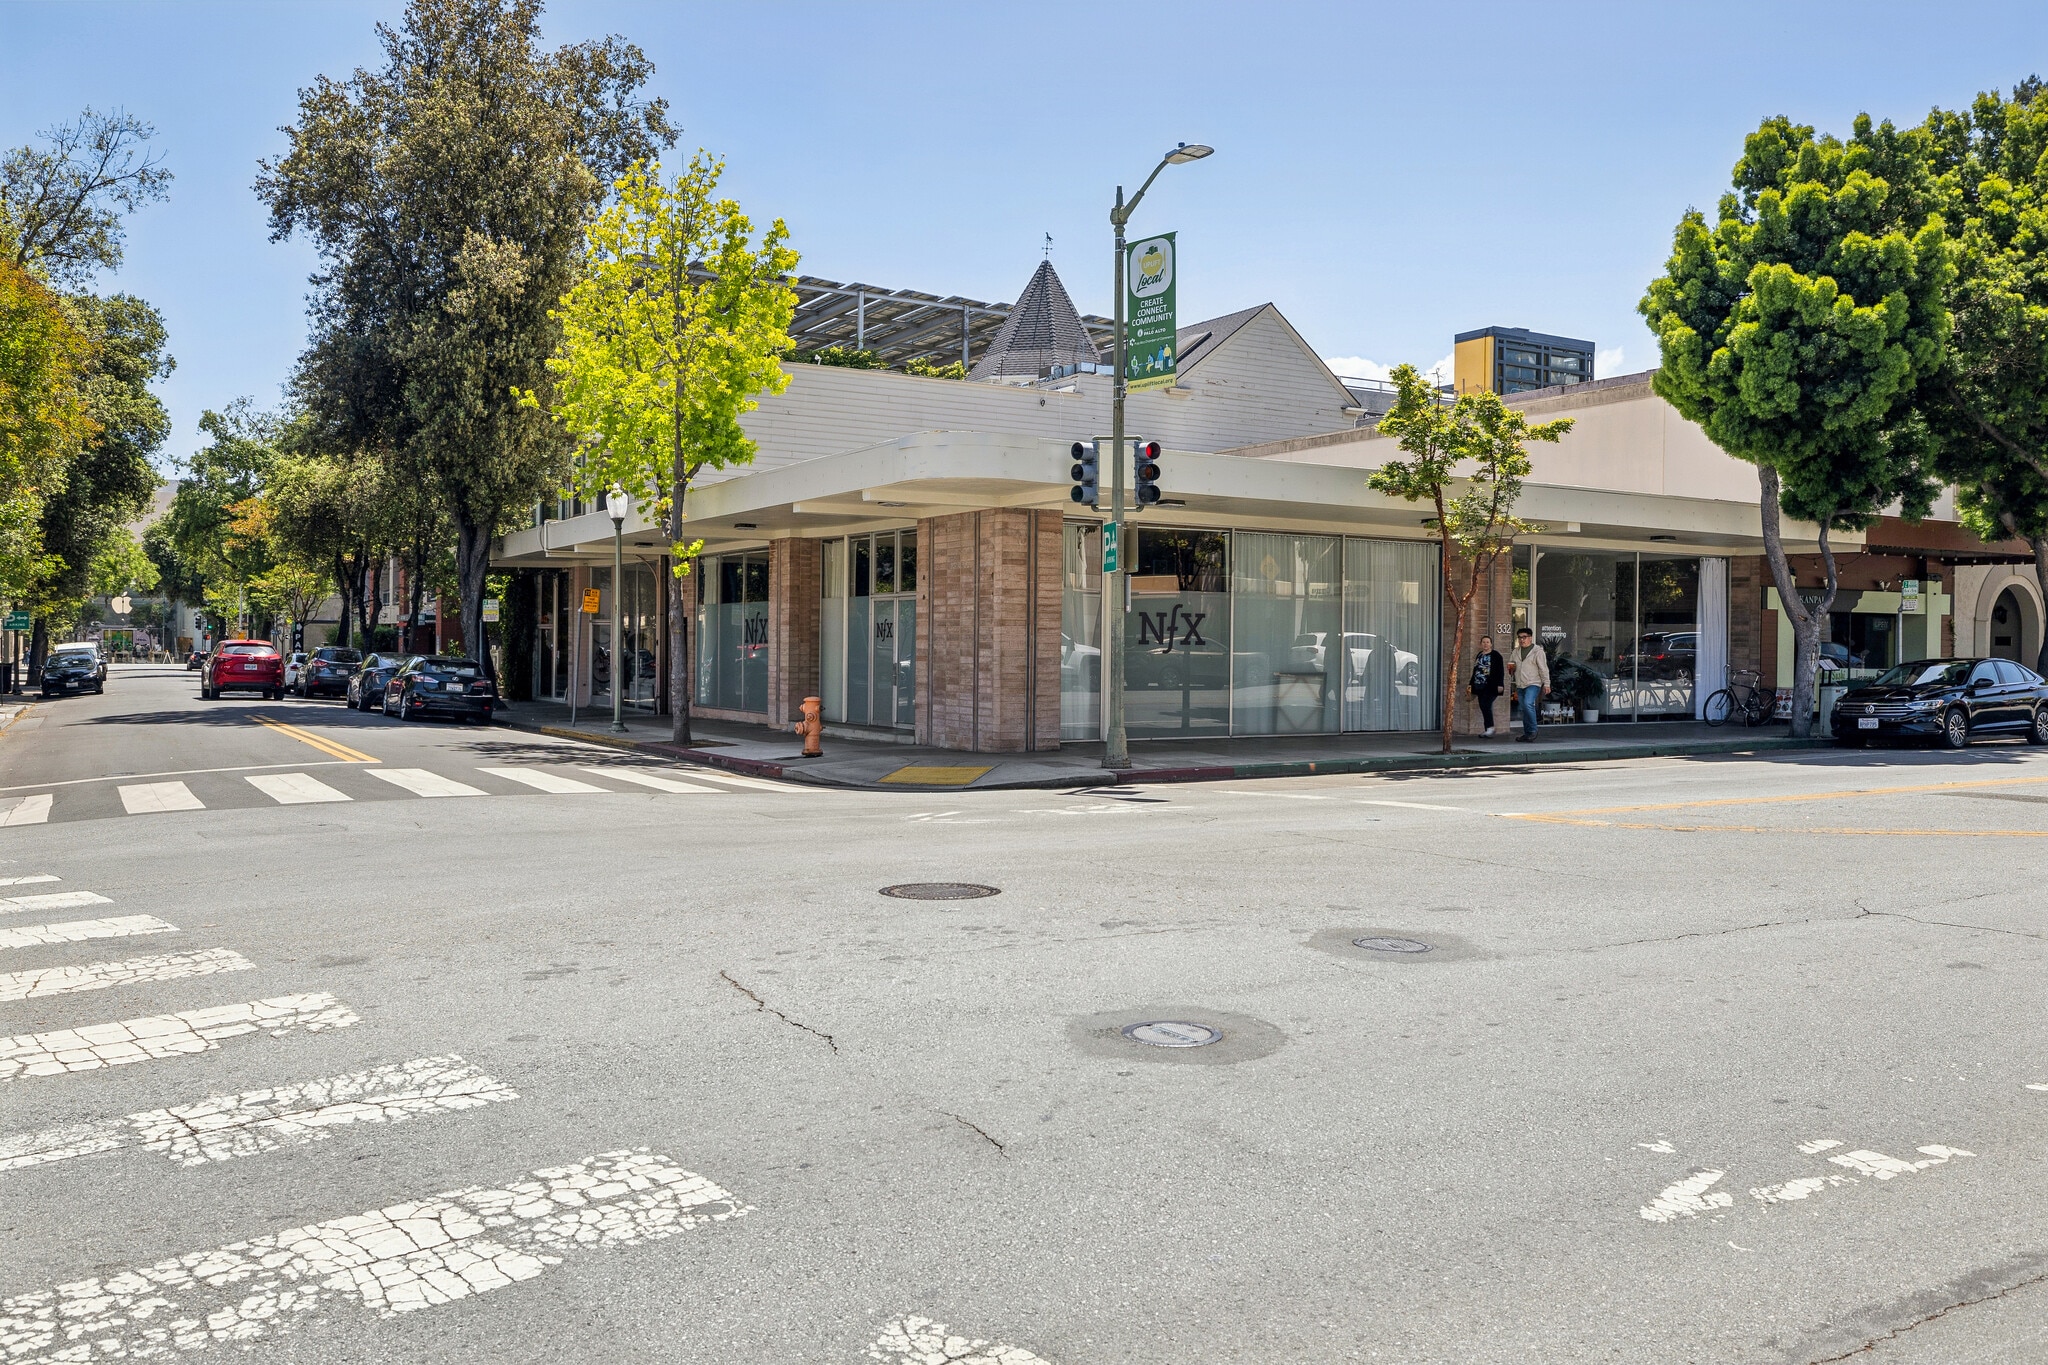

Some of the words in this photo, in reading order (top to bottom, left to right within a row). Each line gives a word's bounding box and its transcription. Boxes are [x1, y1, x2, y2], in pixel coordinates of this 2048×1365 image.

[1143, 259, 1161, 269] UPLIFT
[1136, 268, 1165, 293] Local
[1140, 296, 1164, 308] CREATE
[1137, 304, 1168, 317] CONNECT
[1131, 311, 1173, 327] COMMUNITY
[1130, 378, 1173, 389] www.upliftlocal.org
[1497, 623, 1512, 634] 332
